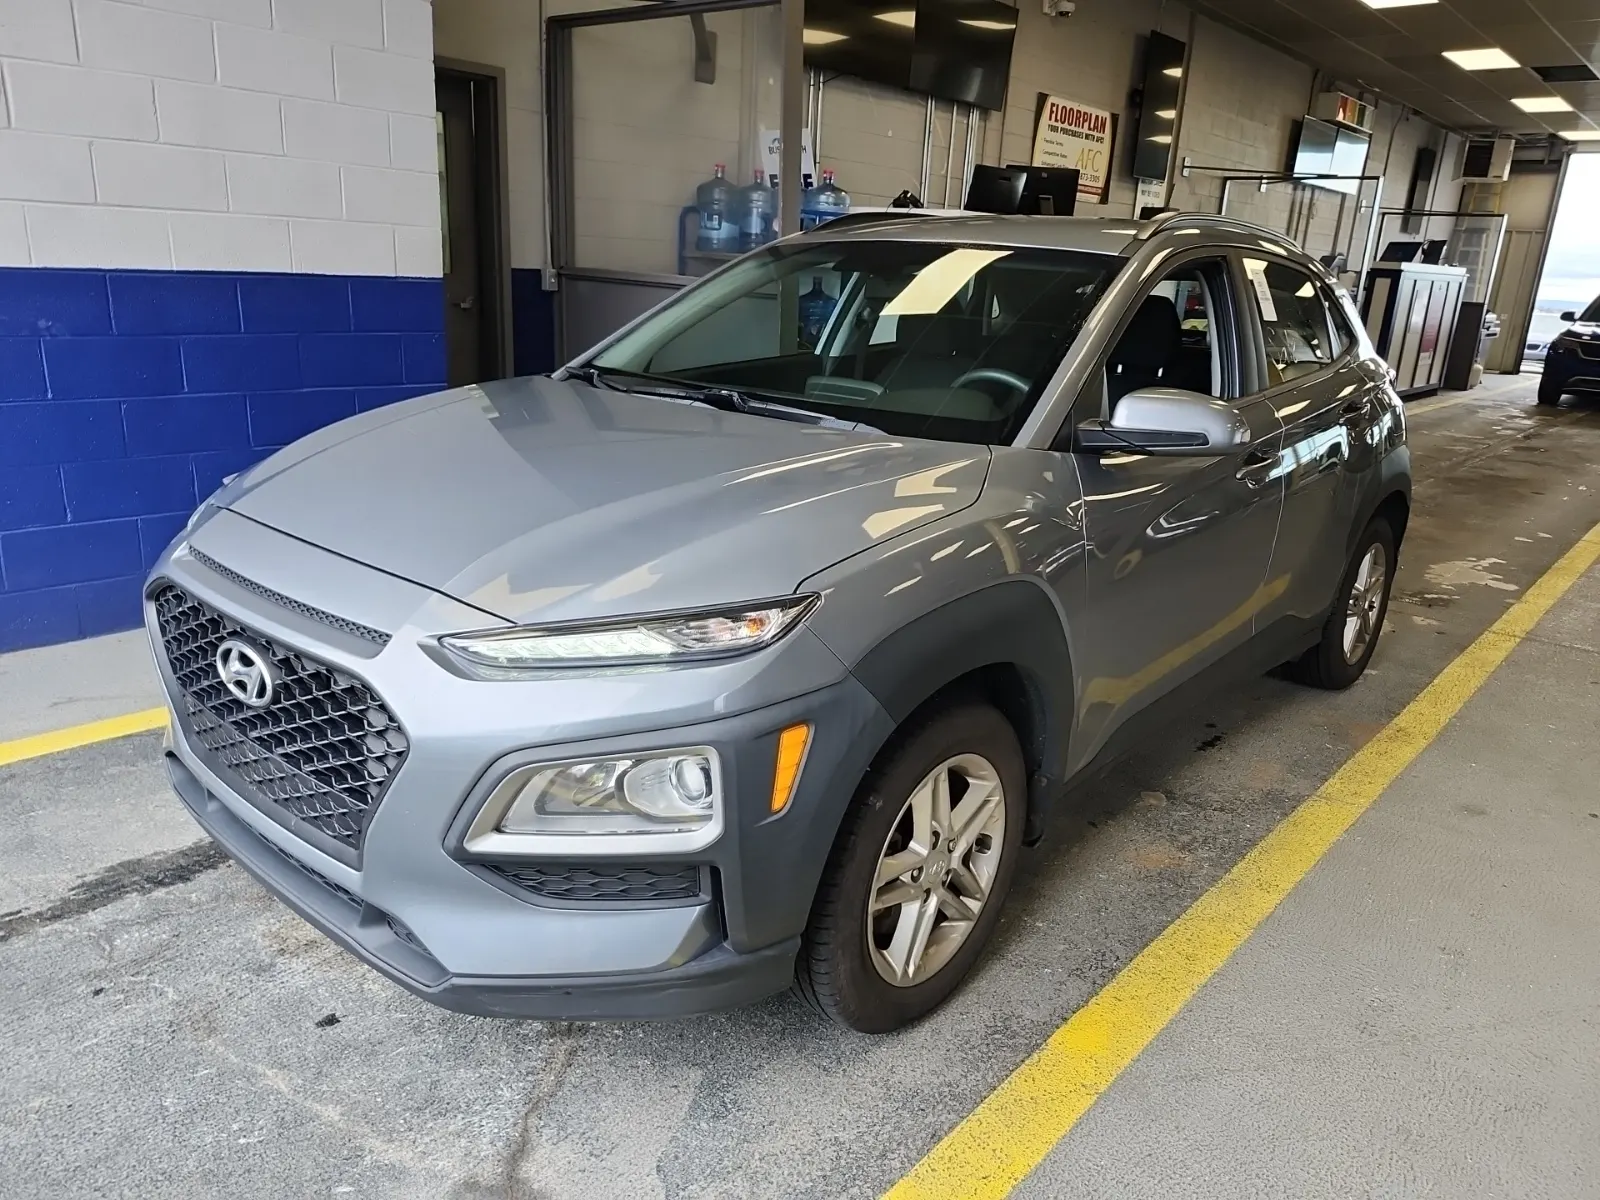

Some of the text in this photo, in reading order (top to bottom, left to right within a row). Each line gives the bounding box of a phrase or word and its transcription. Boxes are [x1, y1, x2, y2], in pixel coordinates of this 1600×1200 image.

[1049, 102, 1107, 134] FLOORPLAN
[1047, 124, 1060, 134] YOUR
[1060, 127, 1084, 140] PURCHASES
[1084, 132, 1096, 143] WITH
[1074, 147, 1103, 173] AFC
